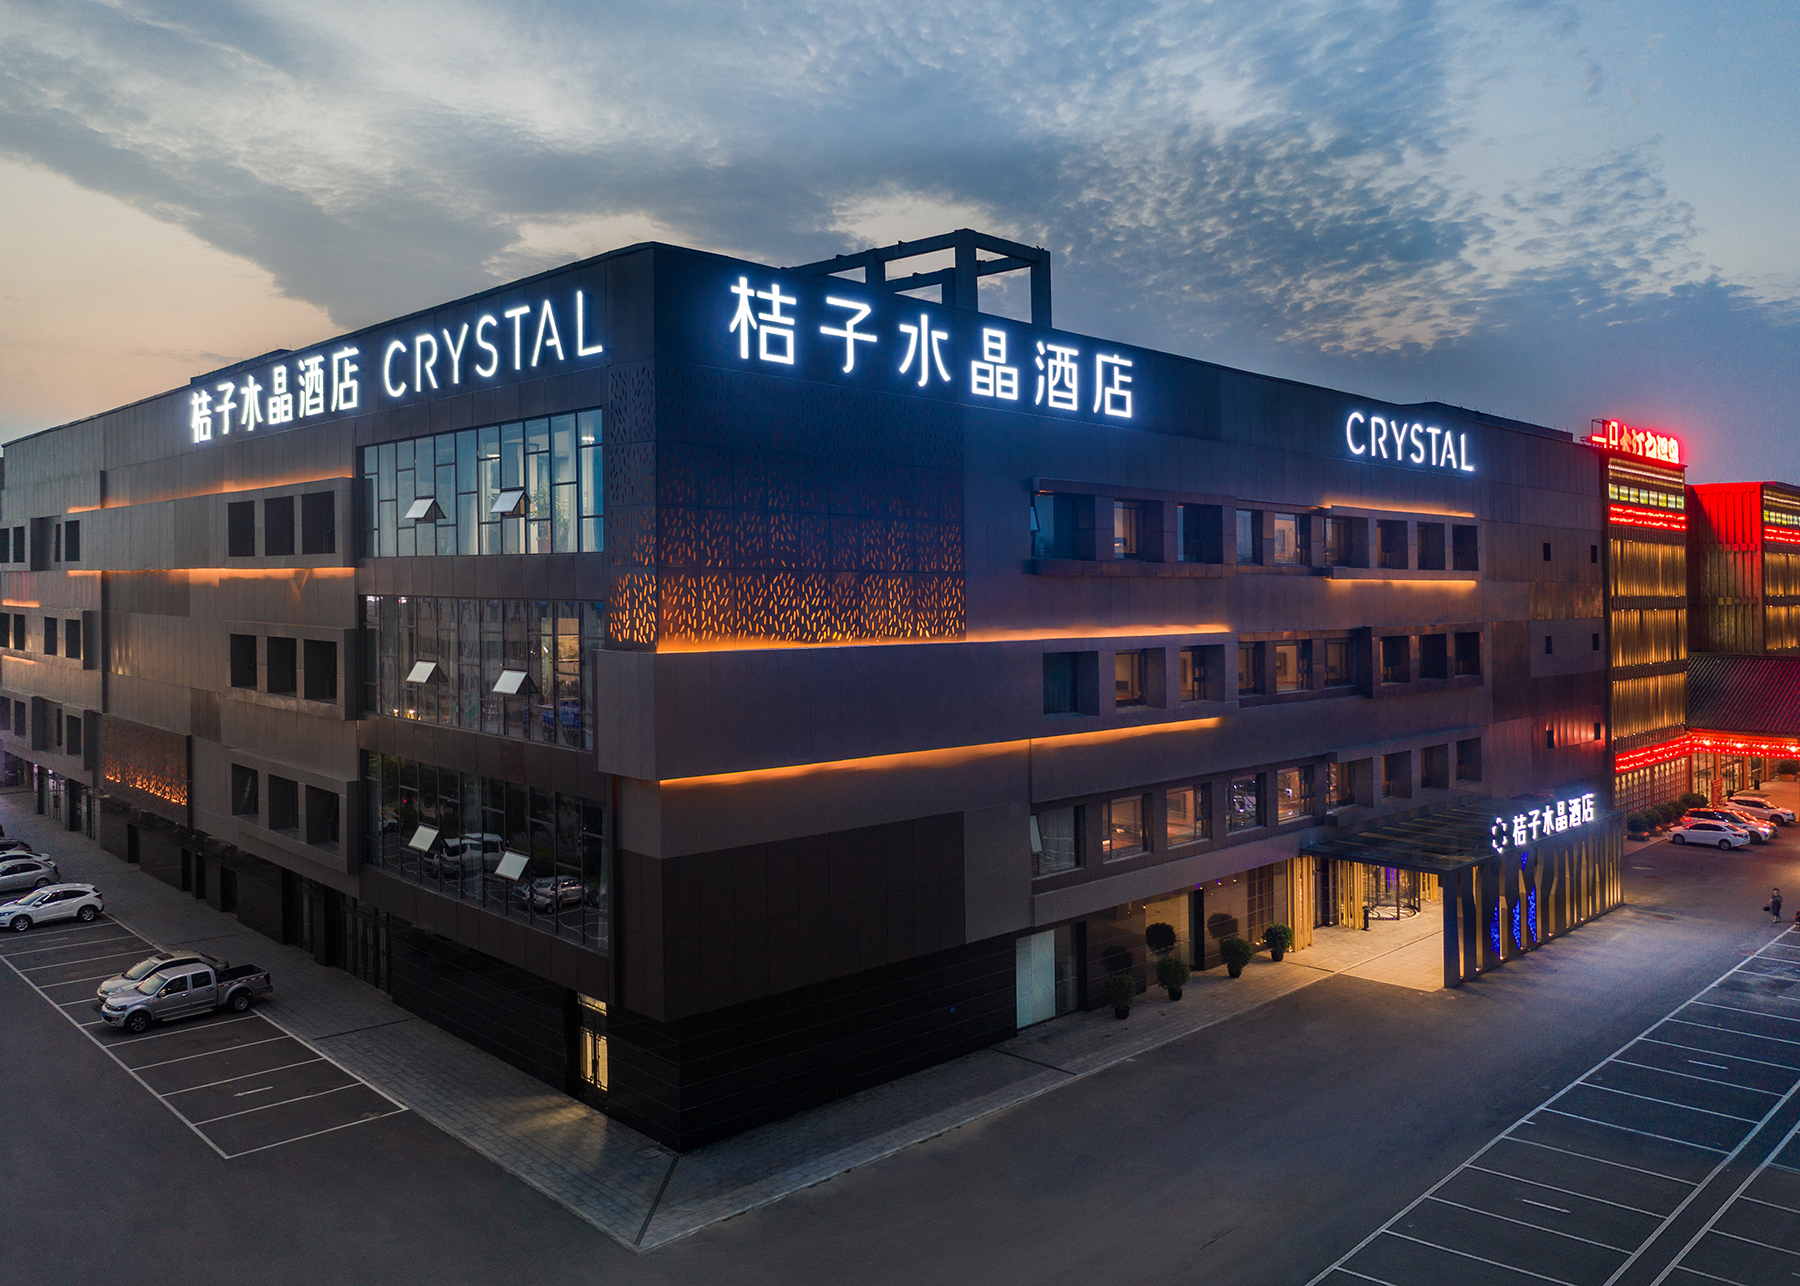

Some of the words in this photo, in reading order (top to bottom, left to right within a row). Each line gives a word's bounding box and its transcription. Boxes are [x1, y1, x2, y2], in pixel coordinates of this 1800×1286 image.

[189, 345, 360, 444] 桔子水晶酒店
[383, 290, 604, 398] CRYSTAL
[730, 275, 1133, 419] 桔子水晶酒店
[1346, 411, 1475, 472] CRYSTAL
[1512, 793, 1595, 847] 桔子水晶酒店
